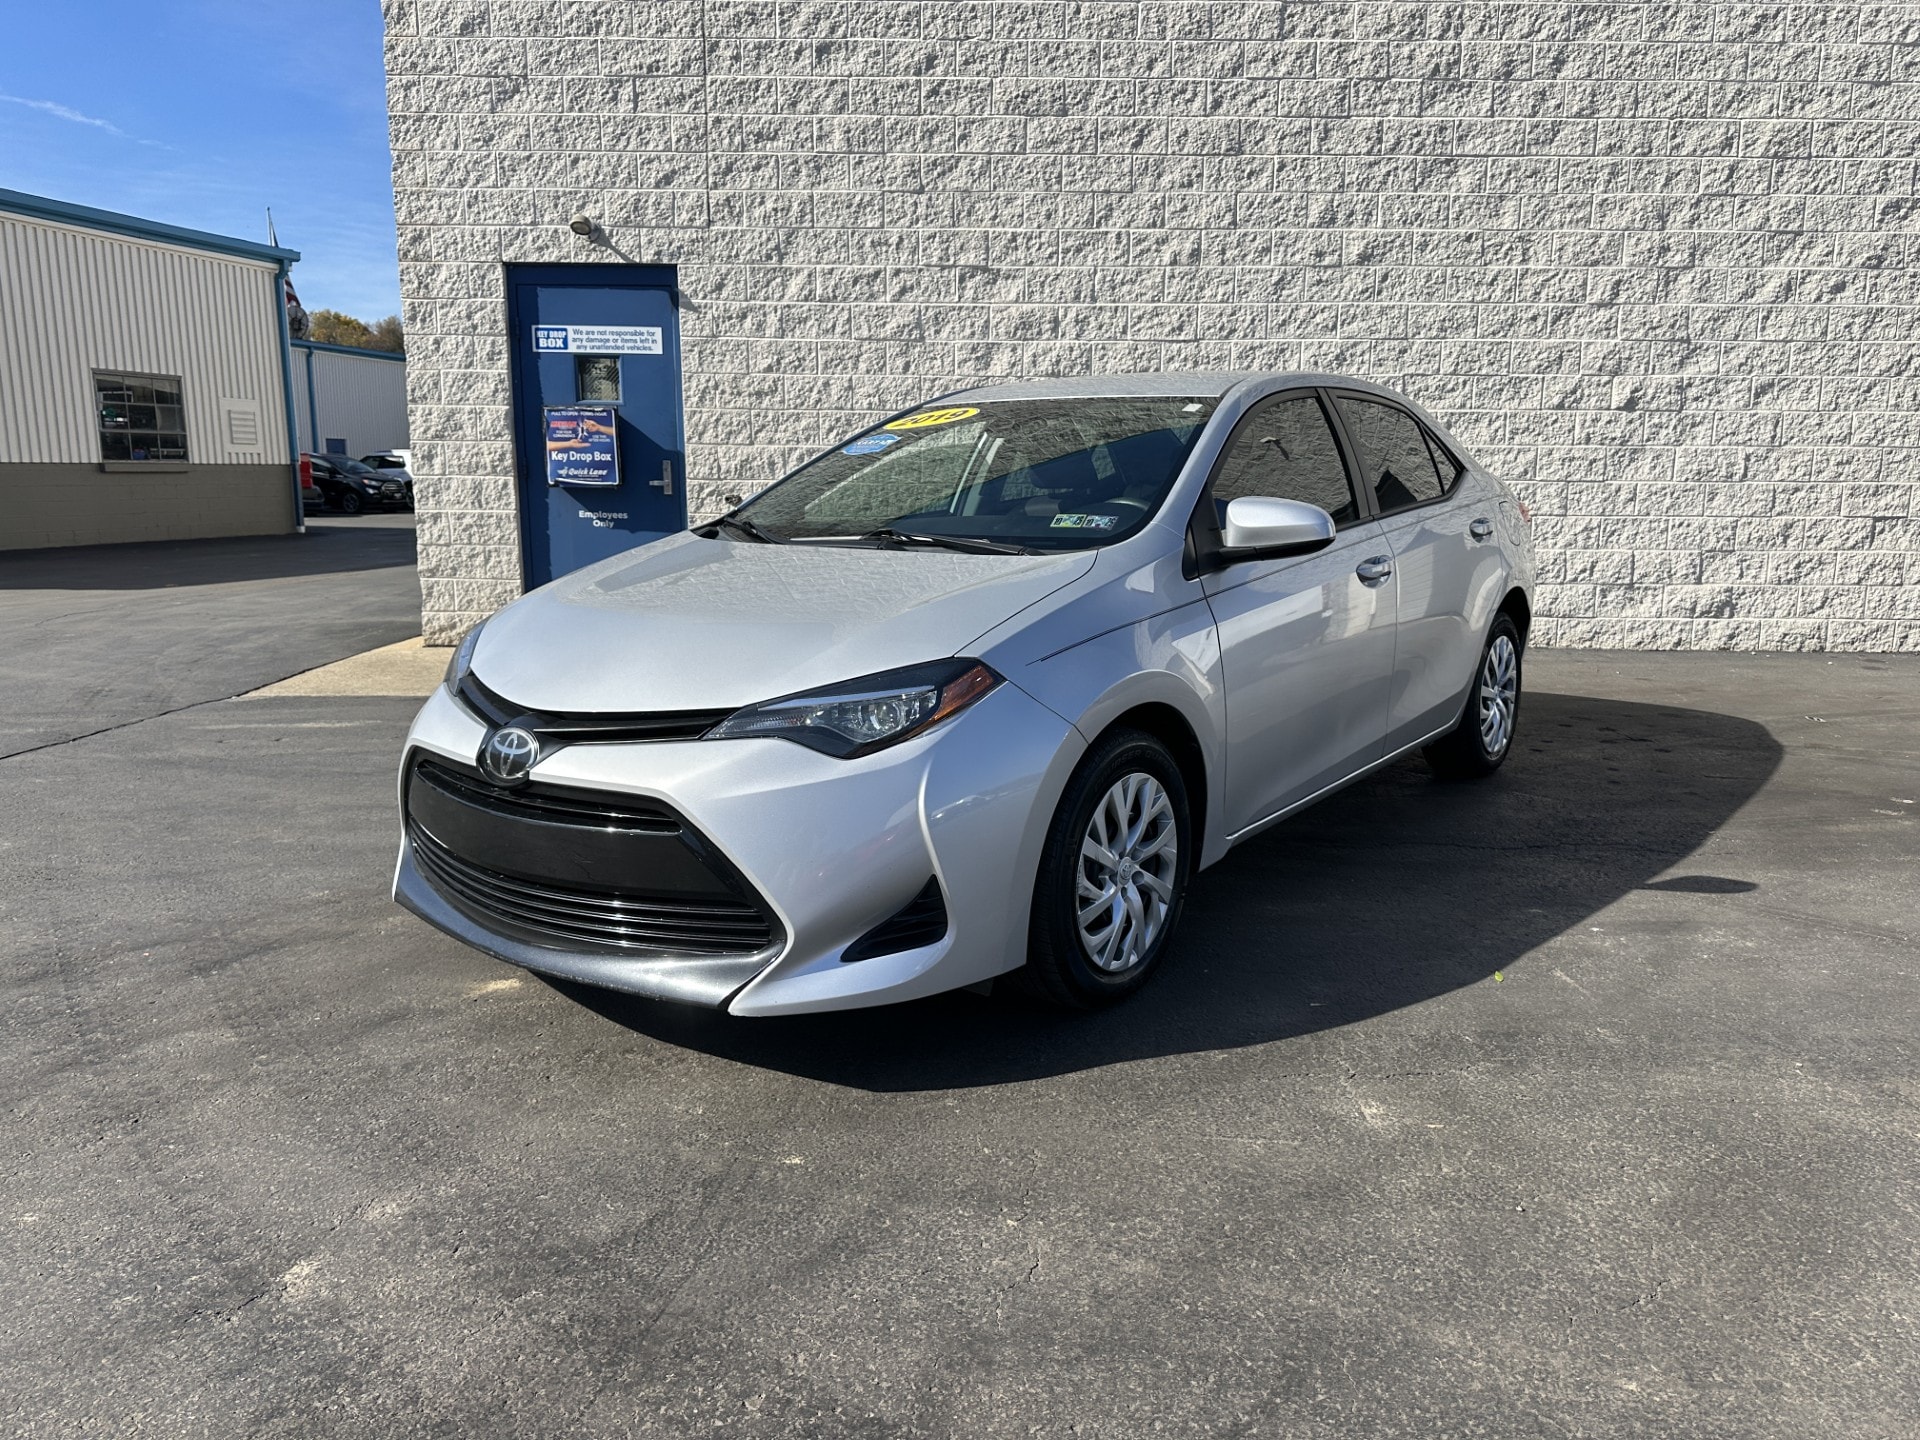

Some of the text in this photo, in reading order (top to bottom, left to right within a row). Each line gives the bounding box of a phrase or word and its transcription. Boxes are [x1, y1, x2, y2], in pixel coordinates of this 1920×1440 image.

[572, 328, 584, 336] We
[608, 330, 645, 338] responsible
[539, 338, 564, 348] BOX
[585, 336, 611, 345] damage
[626, 344, 654, 352] vehicles.
[890, 410, 970, 428] 2019
[551, 451, 611, 463] Key Drop Box
[568, 468, 608, 476] Quick Lane
[578, 510, 628, 520] Employees
[592, 519, 614, 528] Only
